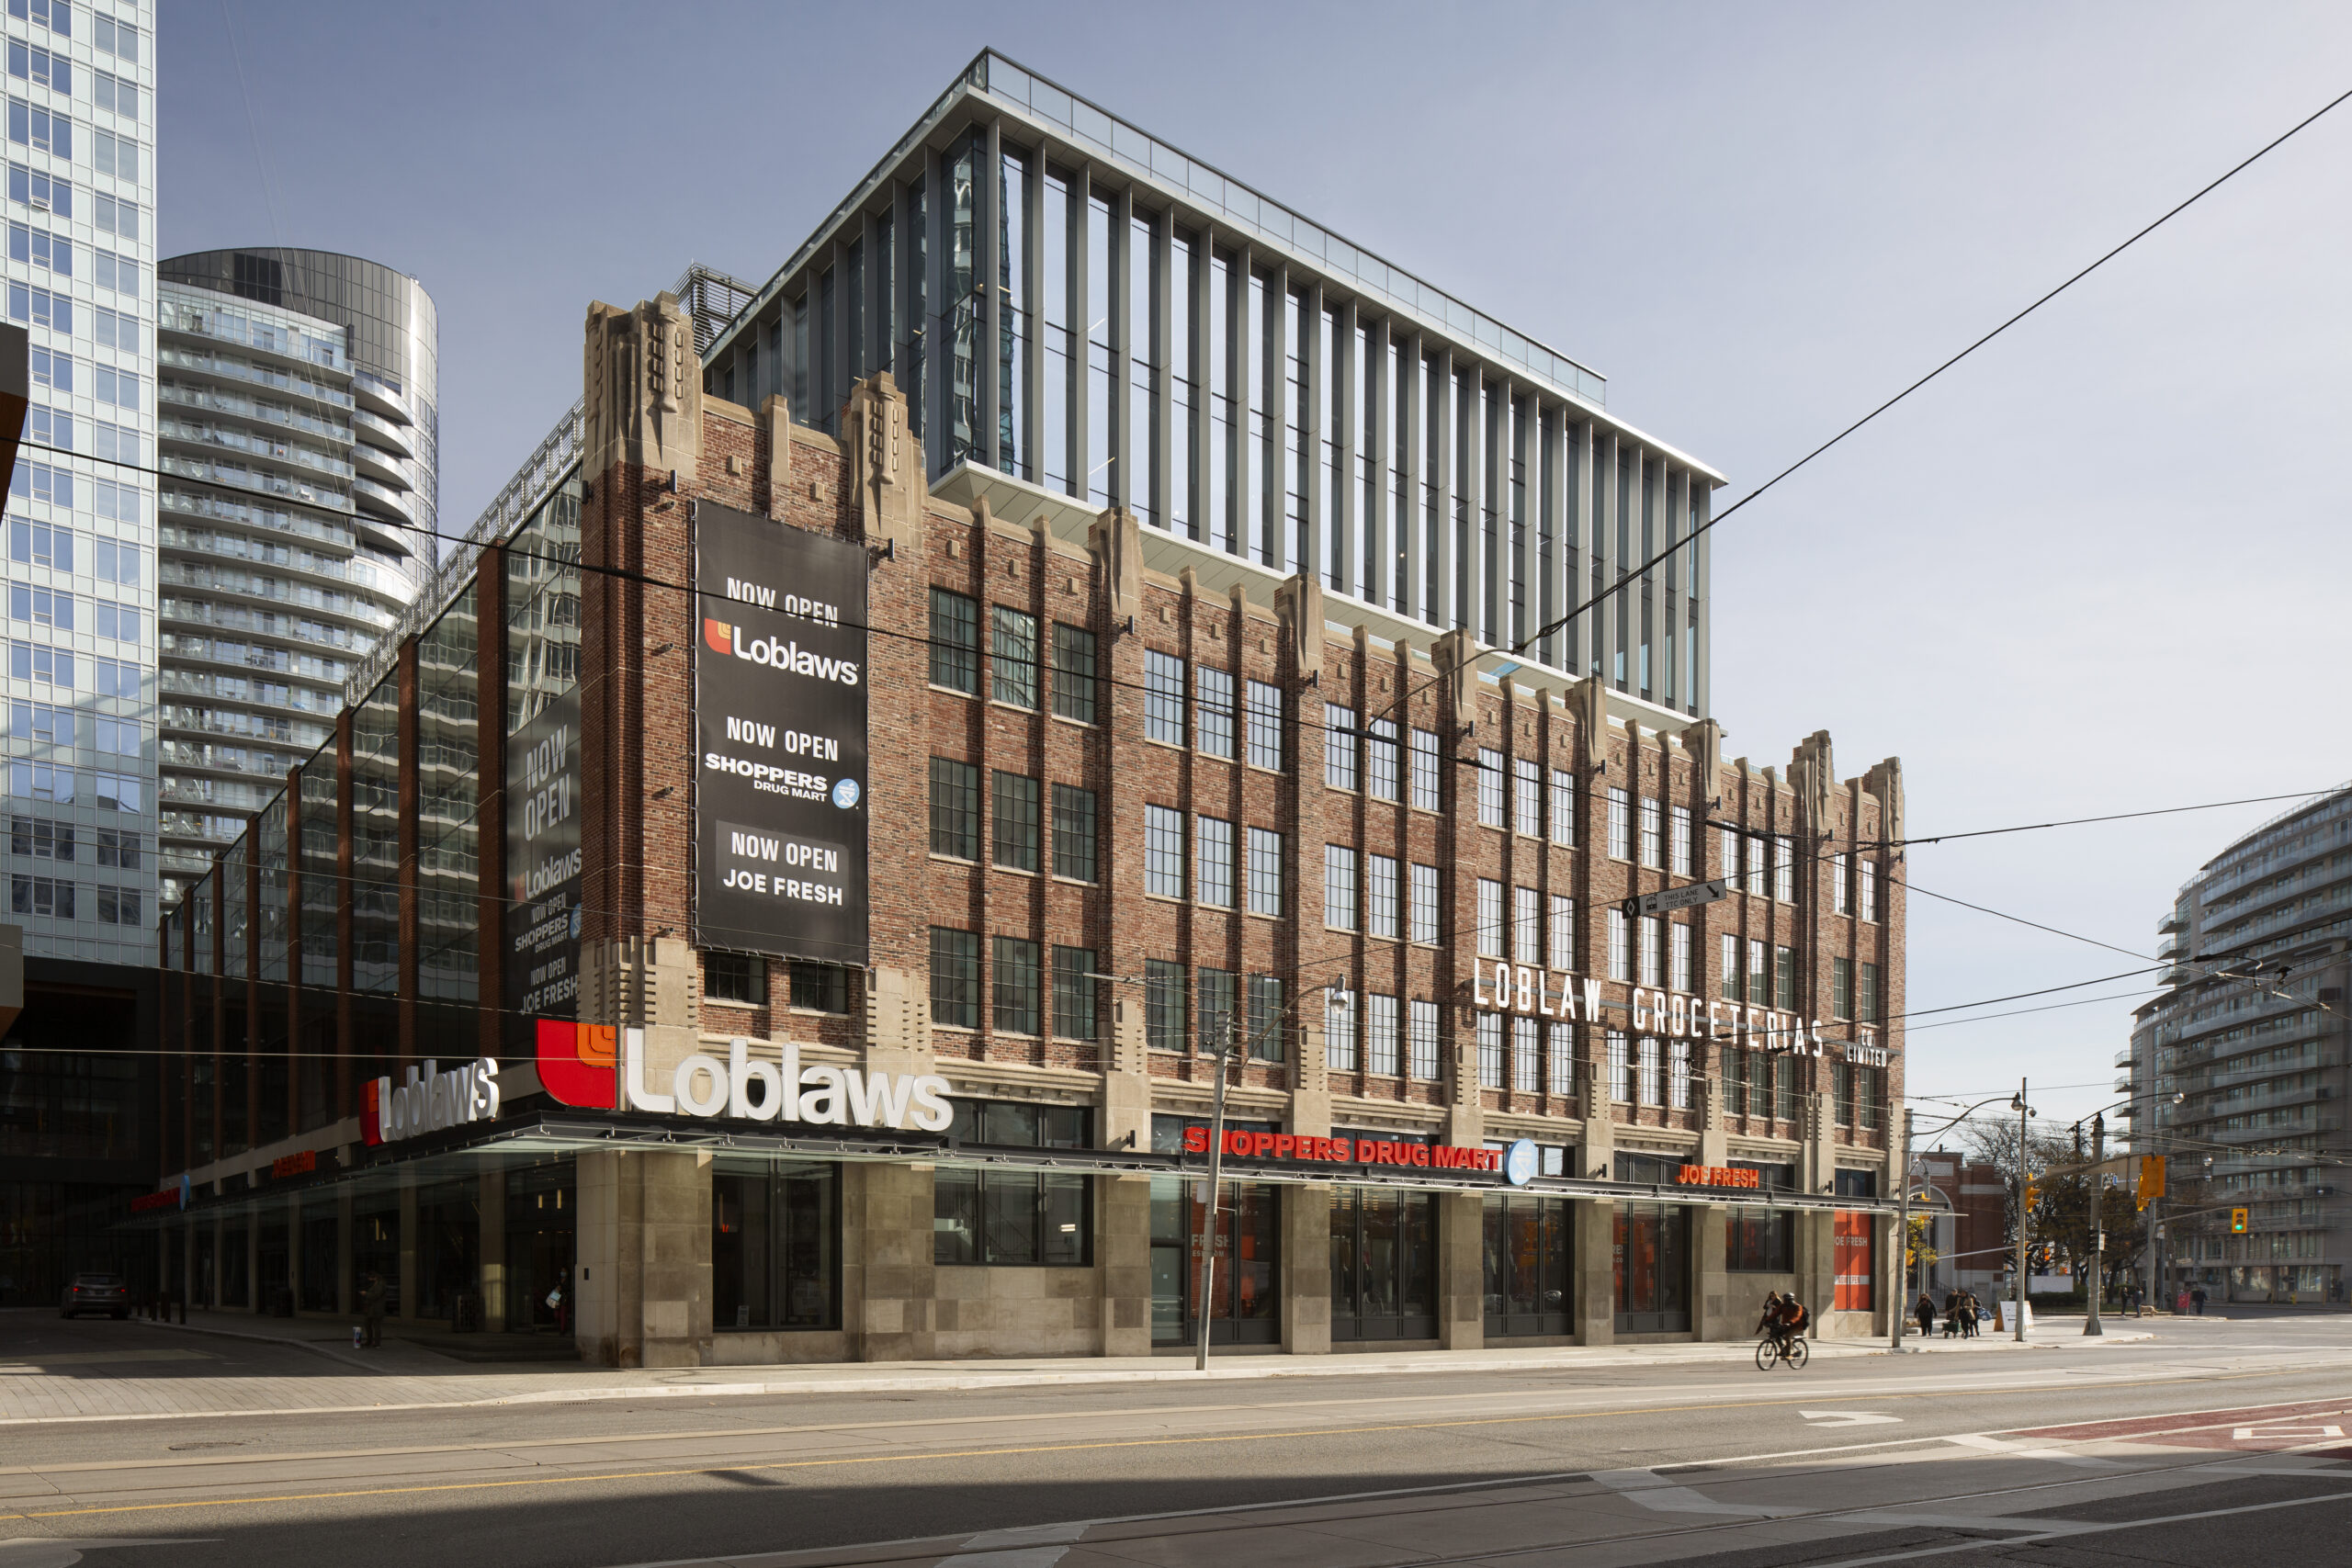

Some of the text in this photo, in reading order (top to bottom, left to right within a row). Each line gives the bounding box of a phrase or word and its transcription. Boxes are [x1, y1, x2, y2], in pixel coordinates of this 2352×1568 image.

[728, 577, 838, 628] NOW OPEN
[733, 626, 858, 685] Loblaws
[526, 724, 568, 792] NOW
[728, 716, 838, 761] NOW OPEN
[705, 752, 827, 792] SHOPPERS
[753, 780, 827, 803] DRUG MART
[525, 773, 570, 841] OPEN
[732, 831, 837, 873] NOW OPEN
[526, 848, 582, 899] Loblaws
[723, 869, 842, 906] JOE FRESH
[531, 891, 566, 925] NOW OPEN
[1664, 888, 1699, 901] THIS LANE
[1666, 897, 1698, 908] TTC ONLY
[514, 913, 568, 953] SHOPPERS
[535, 930, 568, 953] DRUG MART
[530, 956, 566, 987] NOW OPEN
[520, 975, 578, 1016] JOE FRESH
[1474, 958, 1824, 1057] LOBLAW GROCETERIAS
[1847, 1044, 1887, 1067] LIMITED
[624, 1027, 955, 1132] Loblaws
[378, 1057, 500, 1143] Loblaws
[1354, 1139, 1430, 1167] DRUG
[1431, 1145, 1503, 1172] MART
[1676, 1164, 1759, 1189] JOE FRESH
